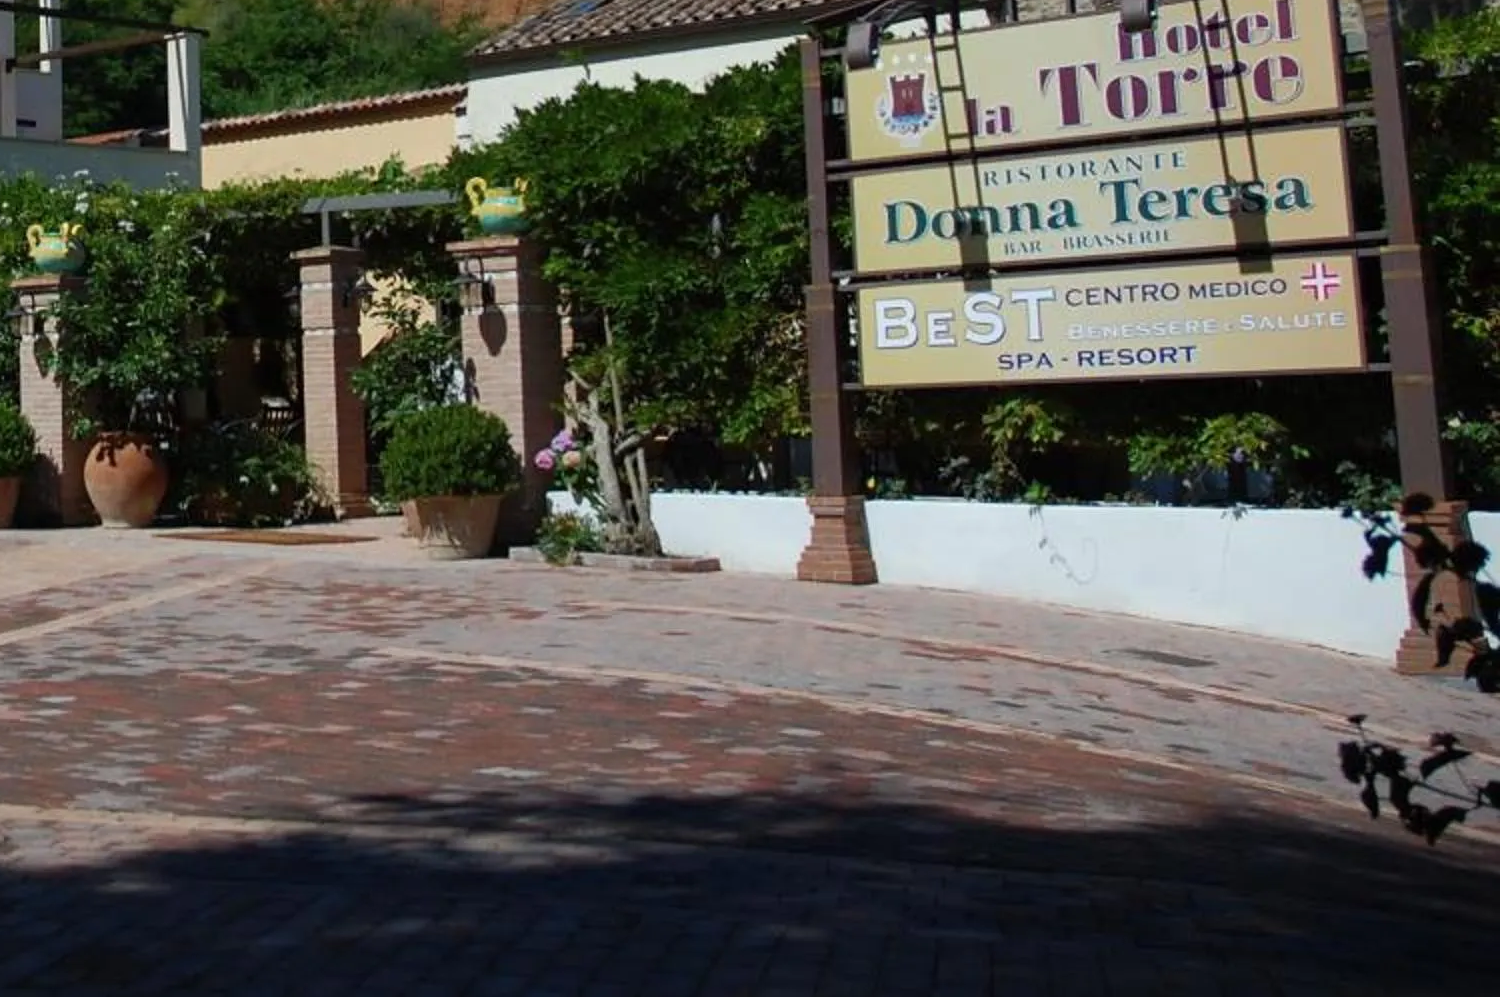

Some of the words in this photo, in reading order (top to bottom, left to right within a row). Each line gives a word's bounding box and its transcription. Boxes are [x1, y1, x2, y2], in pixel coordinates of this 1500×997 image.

[967, 99, 1015, 136] la
[1039, 55, 1304, 128] Torre
[983, 151, 1188, 187] RISTORANTE
[884, 198, 1079, 244] Donna
[1100, 175, 1313, 225] Teresa
[1003, 240, 1042, 256] BAR
[1062, 229, 1170, 251] BRASSERIE
[1065, 281, 1181, 308] CENTRO
[1188, 277, 1288, 302] MEDICO
[1067, 317, 1218, 341] BENESSERE
[1238, 311, 1347, 332] SALUTE
[997, 352, 1054, 371] SPA
[1077, 345, 1197, 368] RESORT
